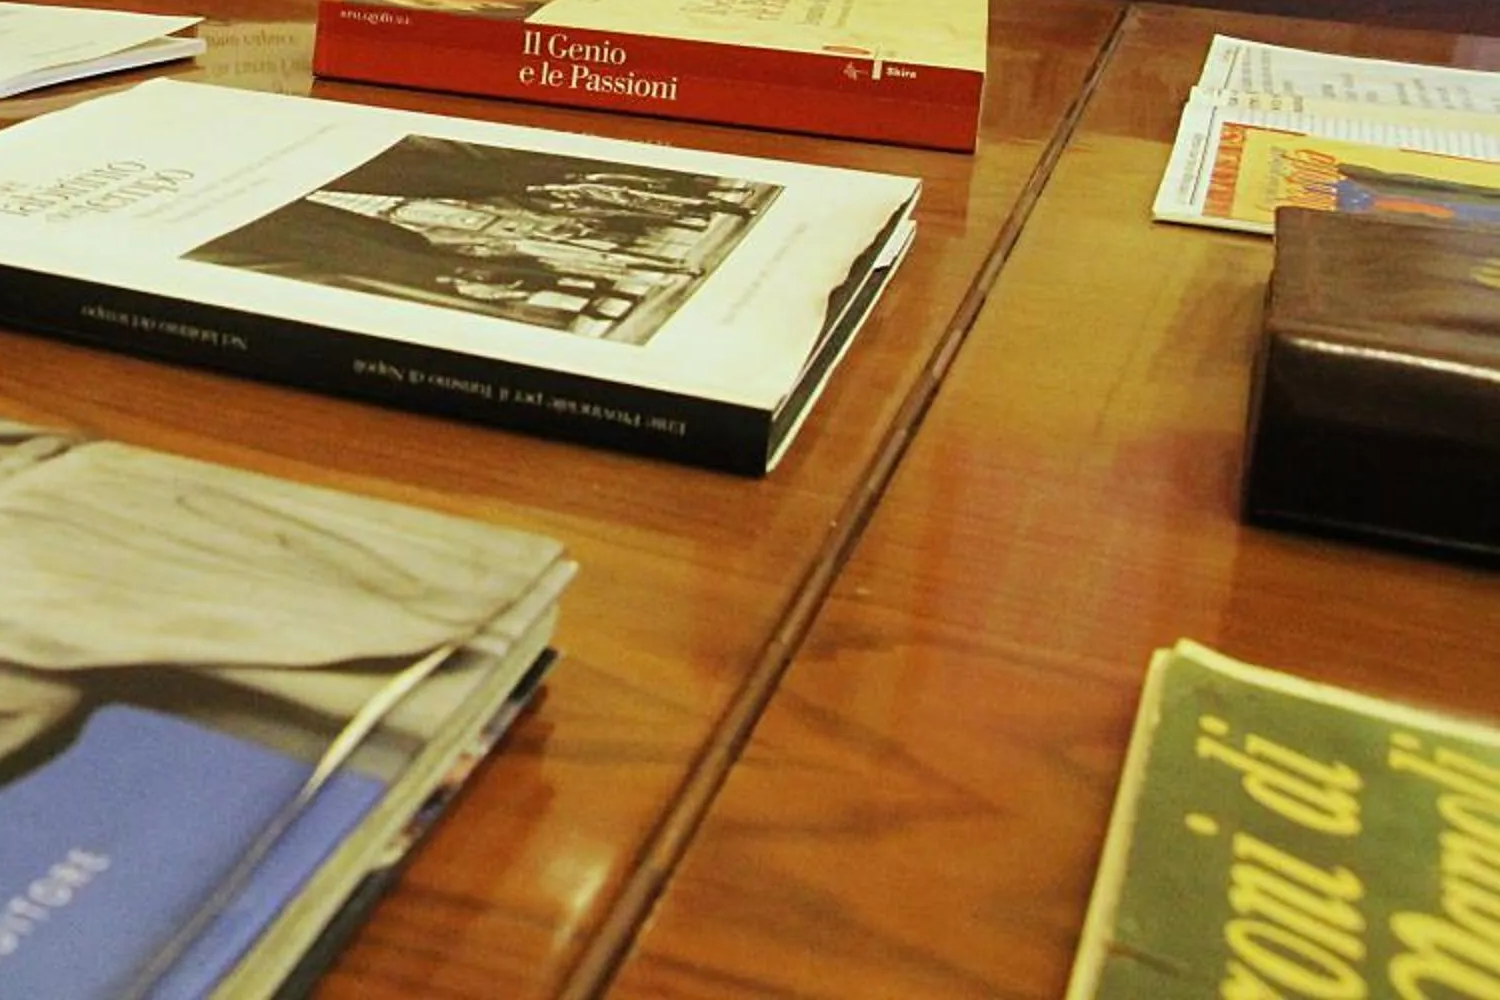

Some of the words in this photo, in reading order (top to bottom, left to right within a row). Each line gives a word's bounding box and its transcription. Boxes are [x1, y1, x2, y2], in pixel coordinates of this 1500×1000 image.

[522, 30, 542, 58] Il
[548, 33, 627, 68] Genio
[518, 67, 534, 86] e
[542, 64, 564, 90] le
[570, 64, 679, 102] Passioni
[351, 357, 406, 381] Napoli
[427, 372, 494, 400] Turismo
[513, 388, 544, 407] per
[544, 395, 643, 429] Provinciale
[1196, 714, 1364, 836] di
